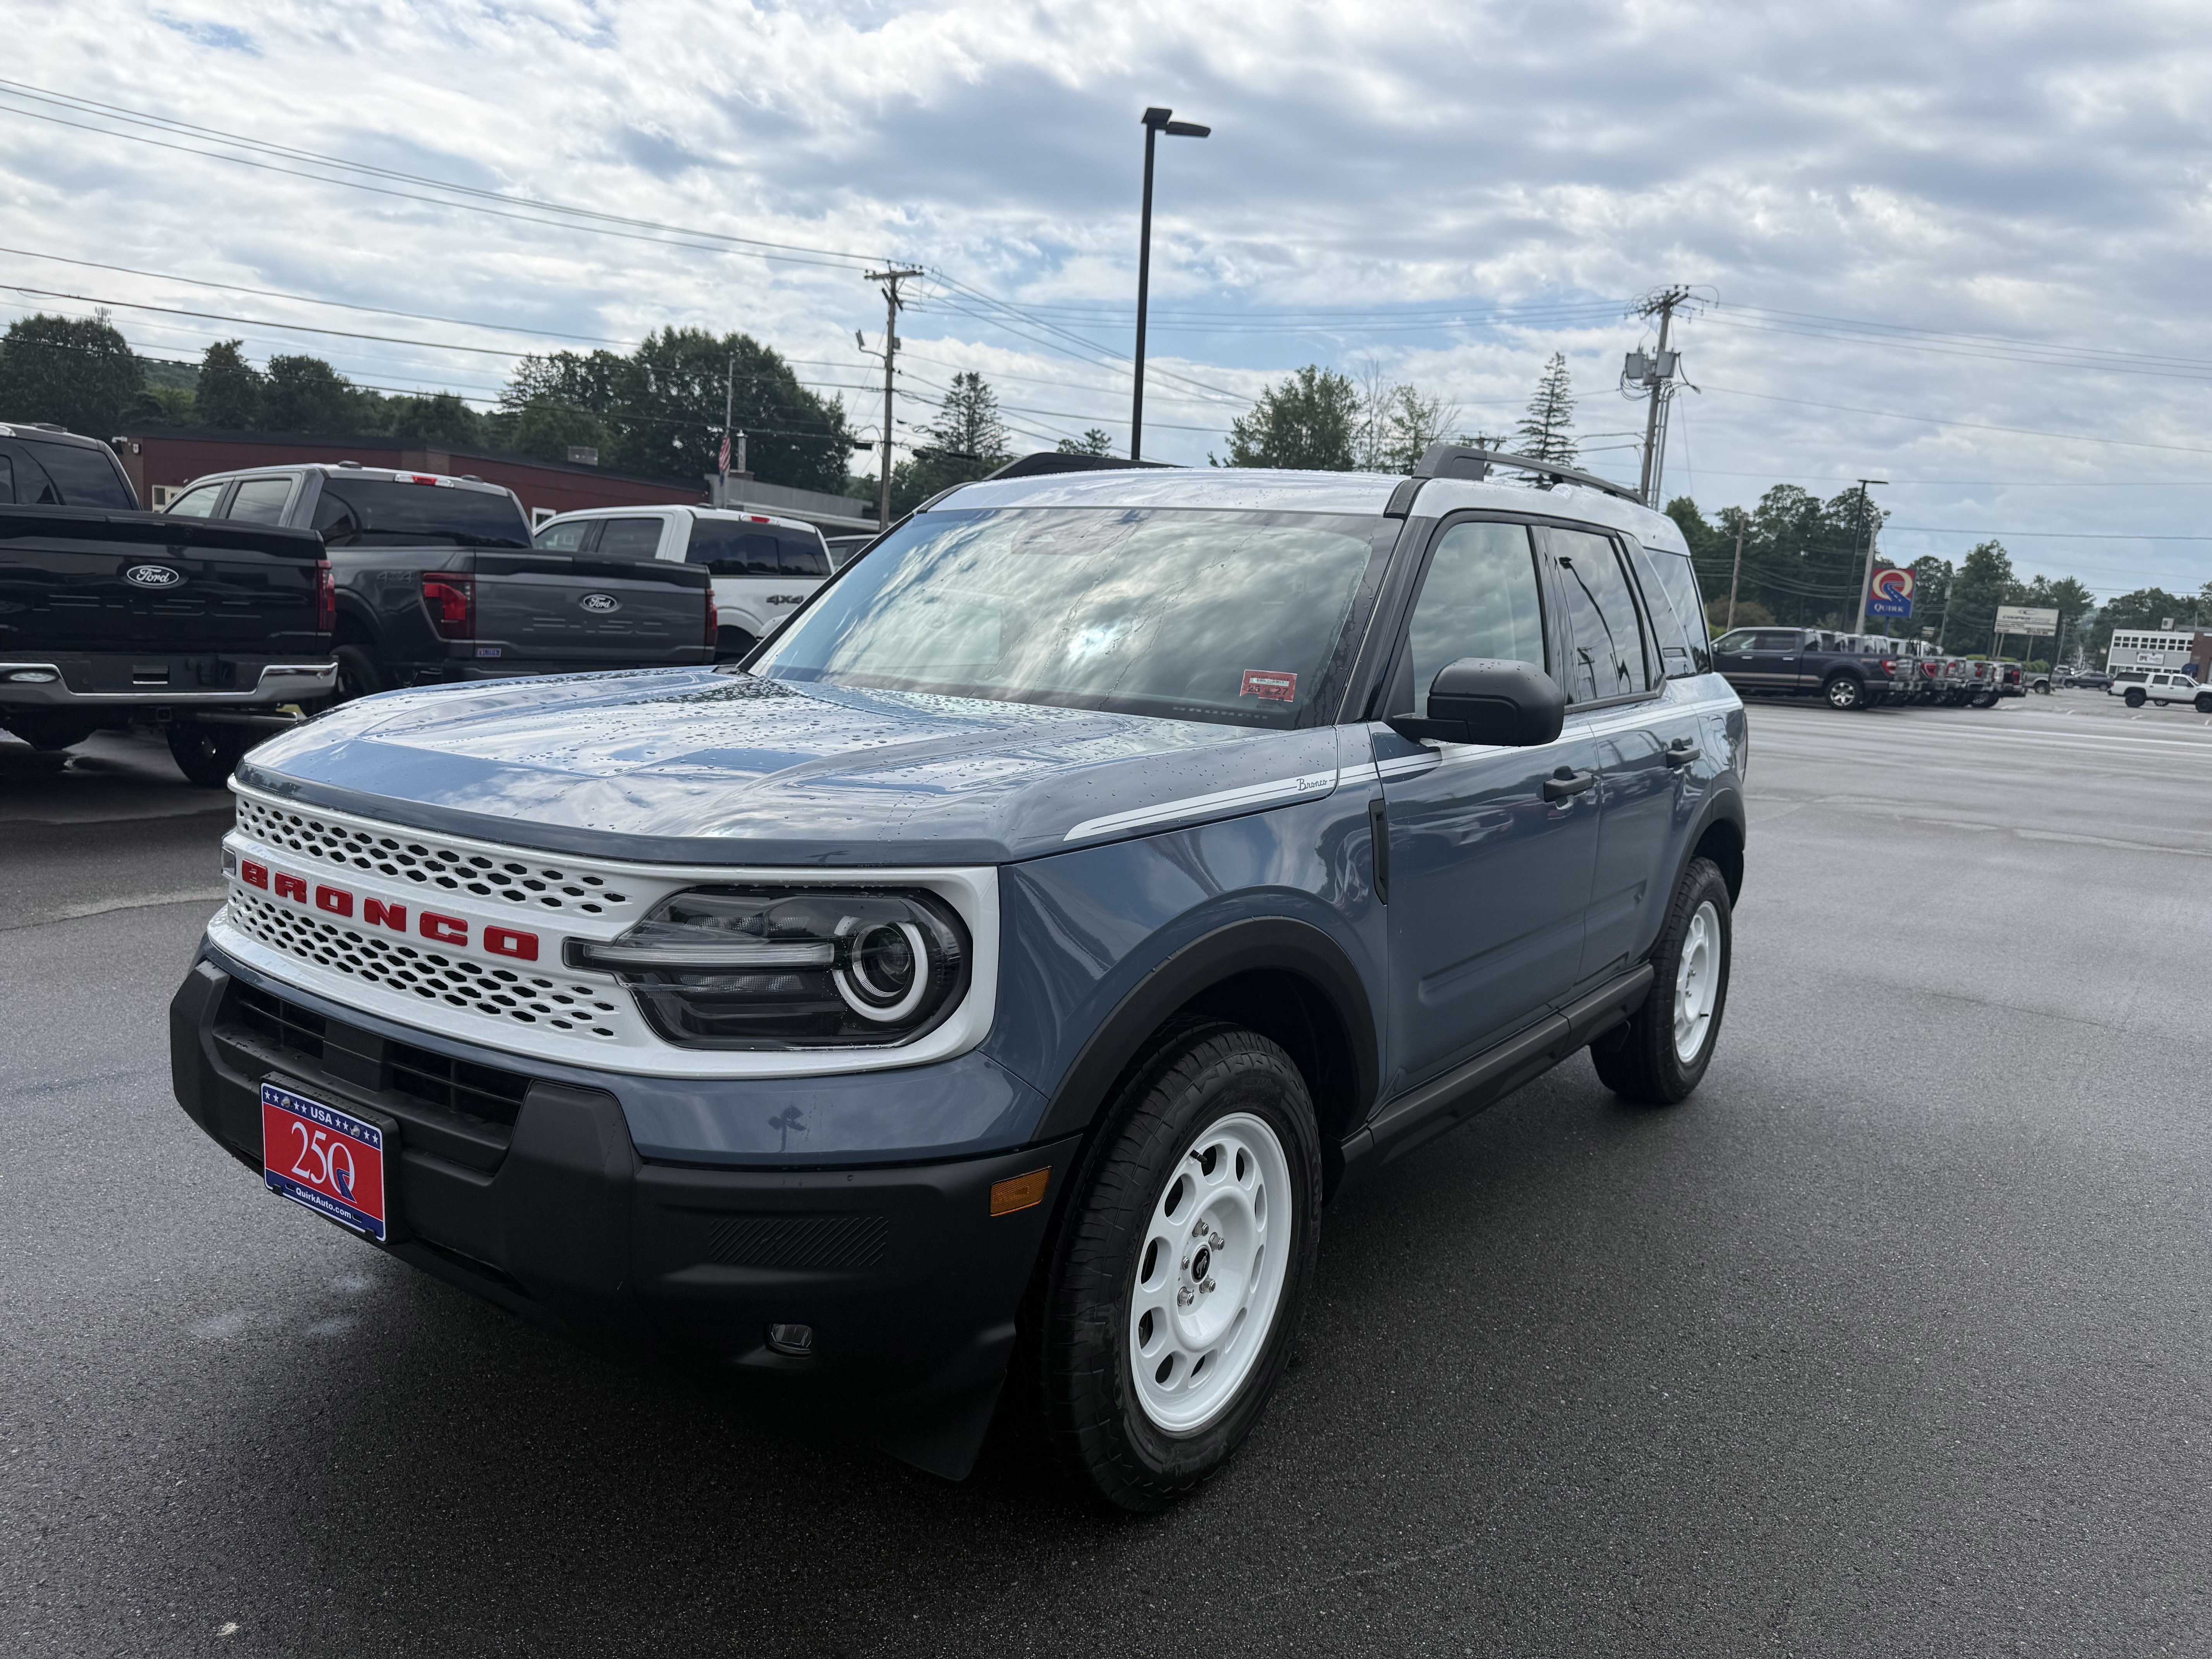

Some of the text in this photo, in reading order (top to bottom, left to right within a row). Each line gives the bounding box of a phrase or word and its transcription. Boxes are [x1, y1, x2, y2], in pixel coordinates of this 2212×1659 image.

[136, 568, 170, 582] Ford
[589, 596, 611, 608] Ford
[1874, 603, 1903, 612] QUIRK
[1274, 687, 1289, 695] 27
[1296, 778, 1328, 791] Bronco
[242, 859, 539, 962] BRONCO
[310, 1106, 333, 1125] USA
[296, 1187, 352, 1219] QuirkAuto.com
